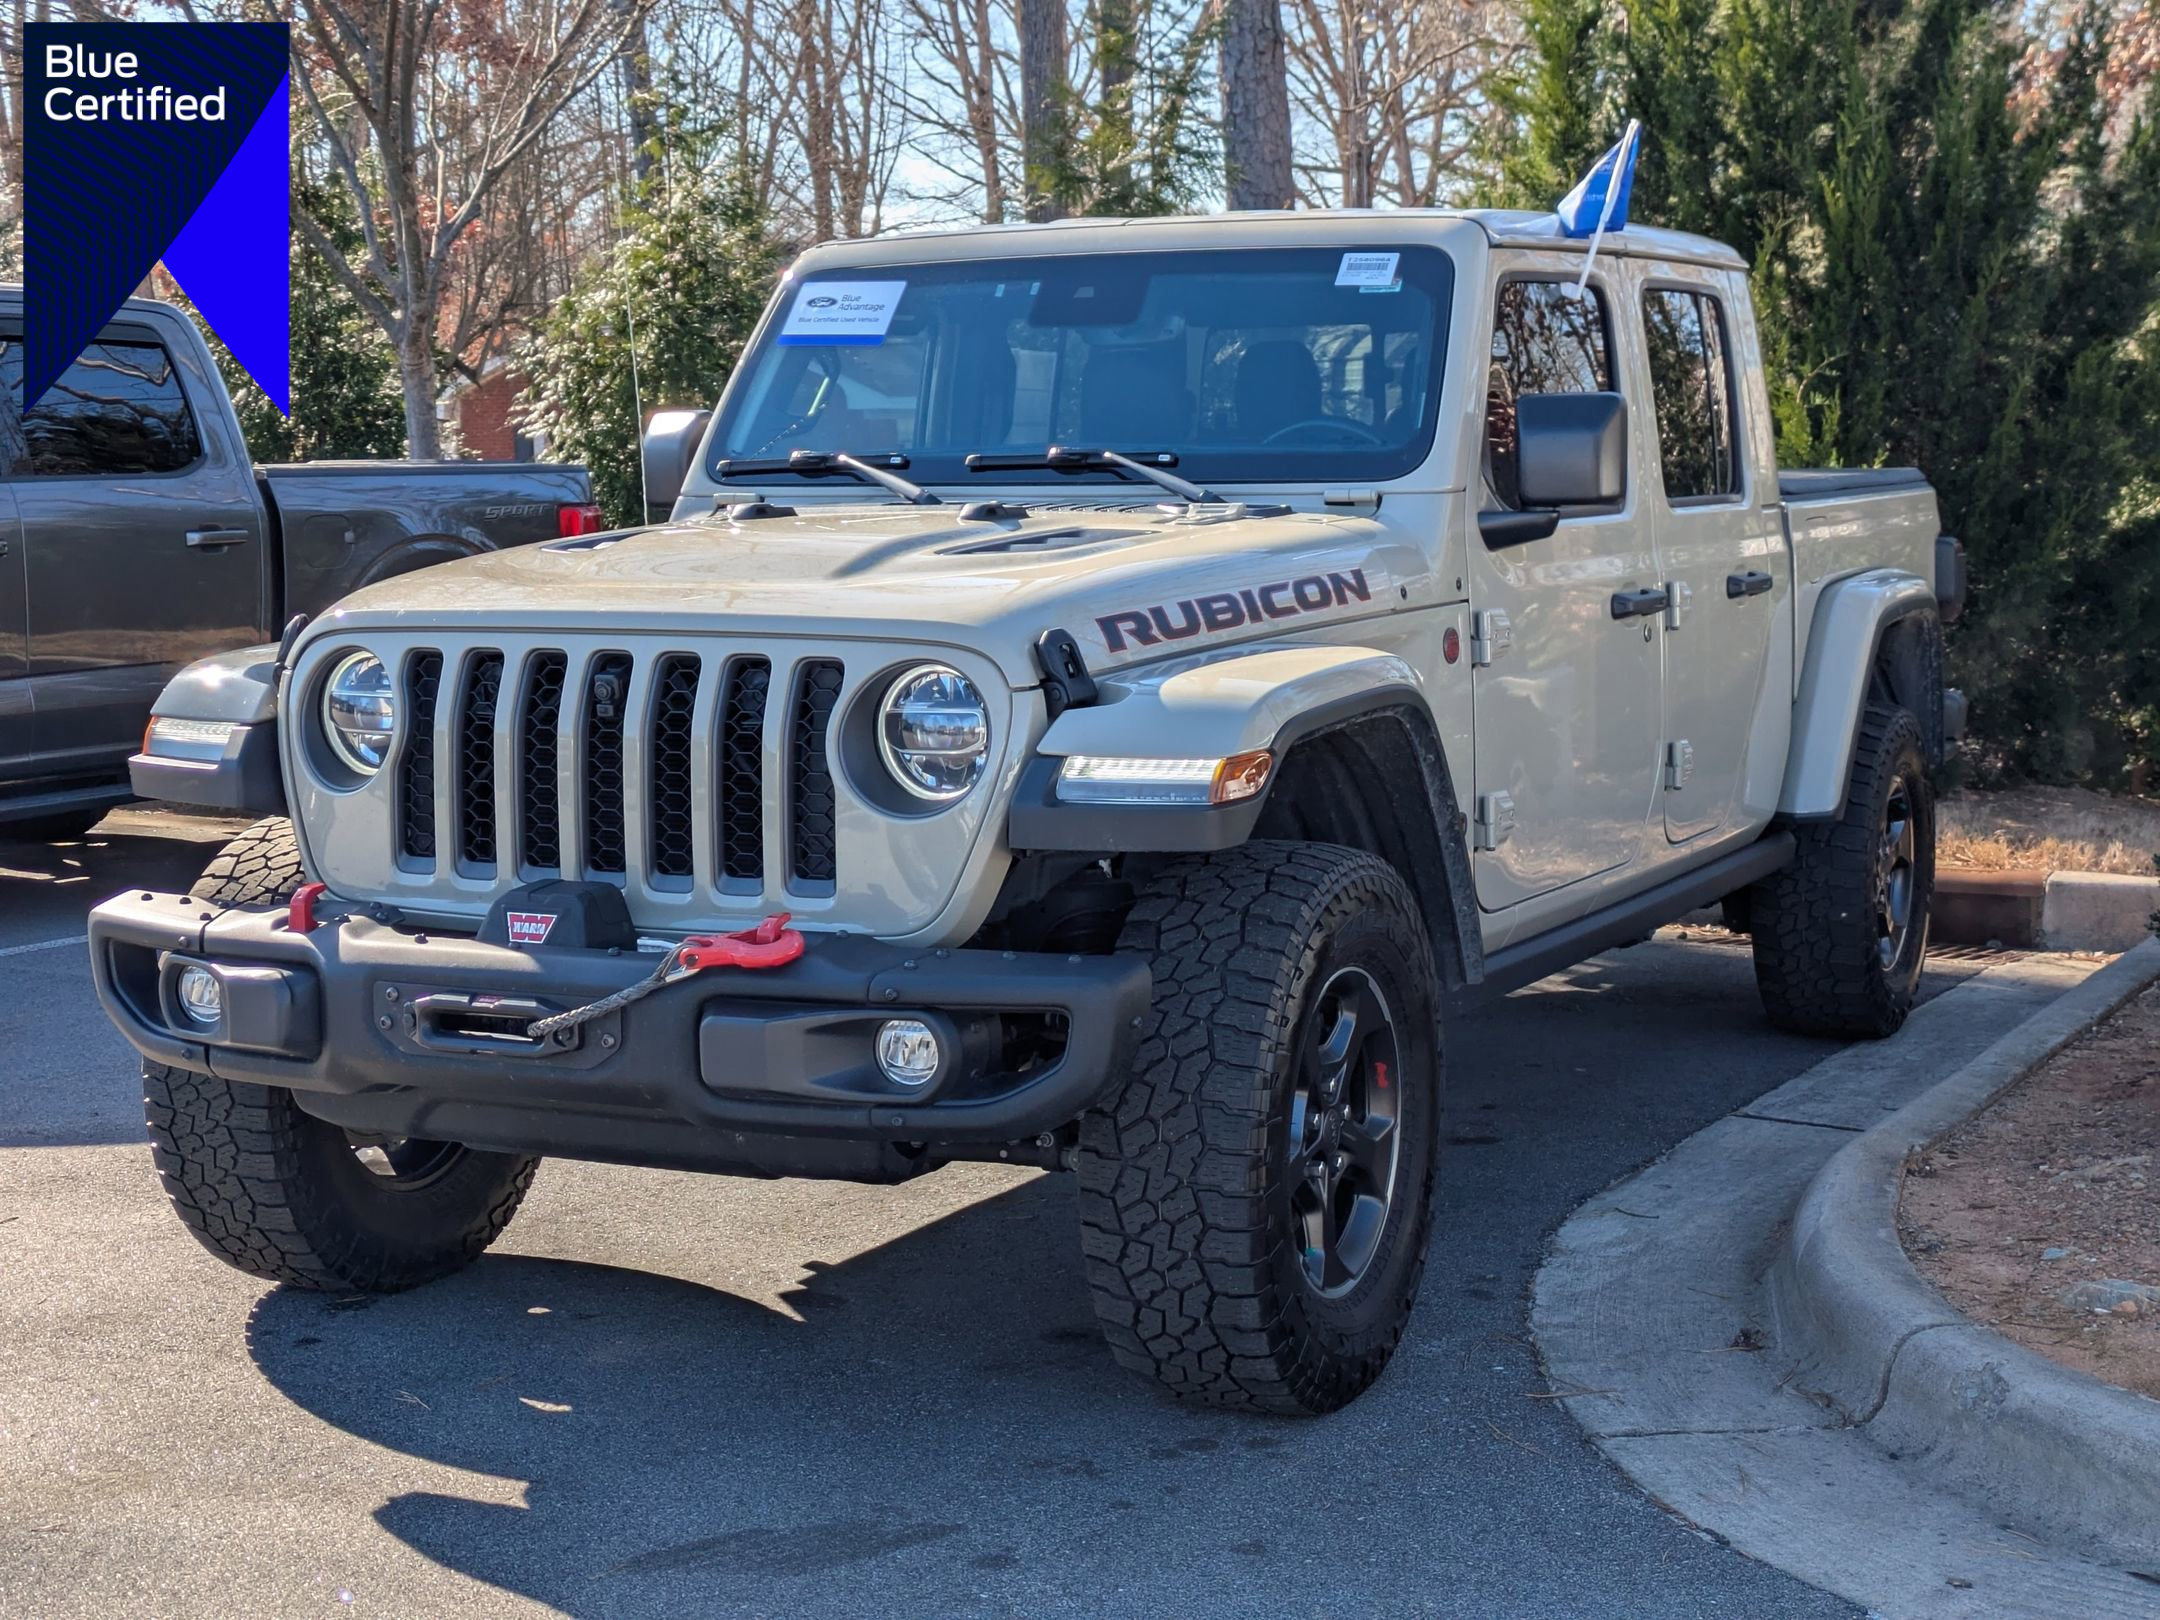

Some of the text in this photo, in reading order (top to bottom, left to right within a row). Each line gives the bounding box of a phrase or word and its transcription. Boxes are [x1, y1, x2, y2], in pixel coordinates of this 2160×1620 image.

[841, 294, 862, 302] Blue
[838, 303, 885, 312] Advantage
[484, 504, 550, 519] SPORT
[1095, 568, 1371, 653] RUBICON
[513, 921, 545, 935] WARN
